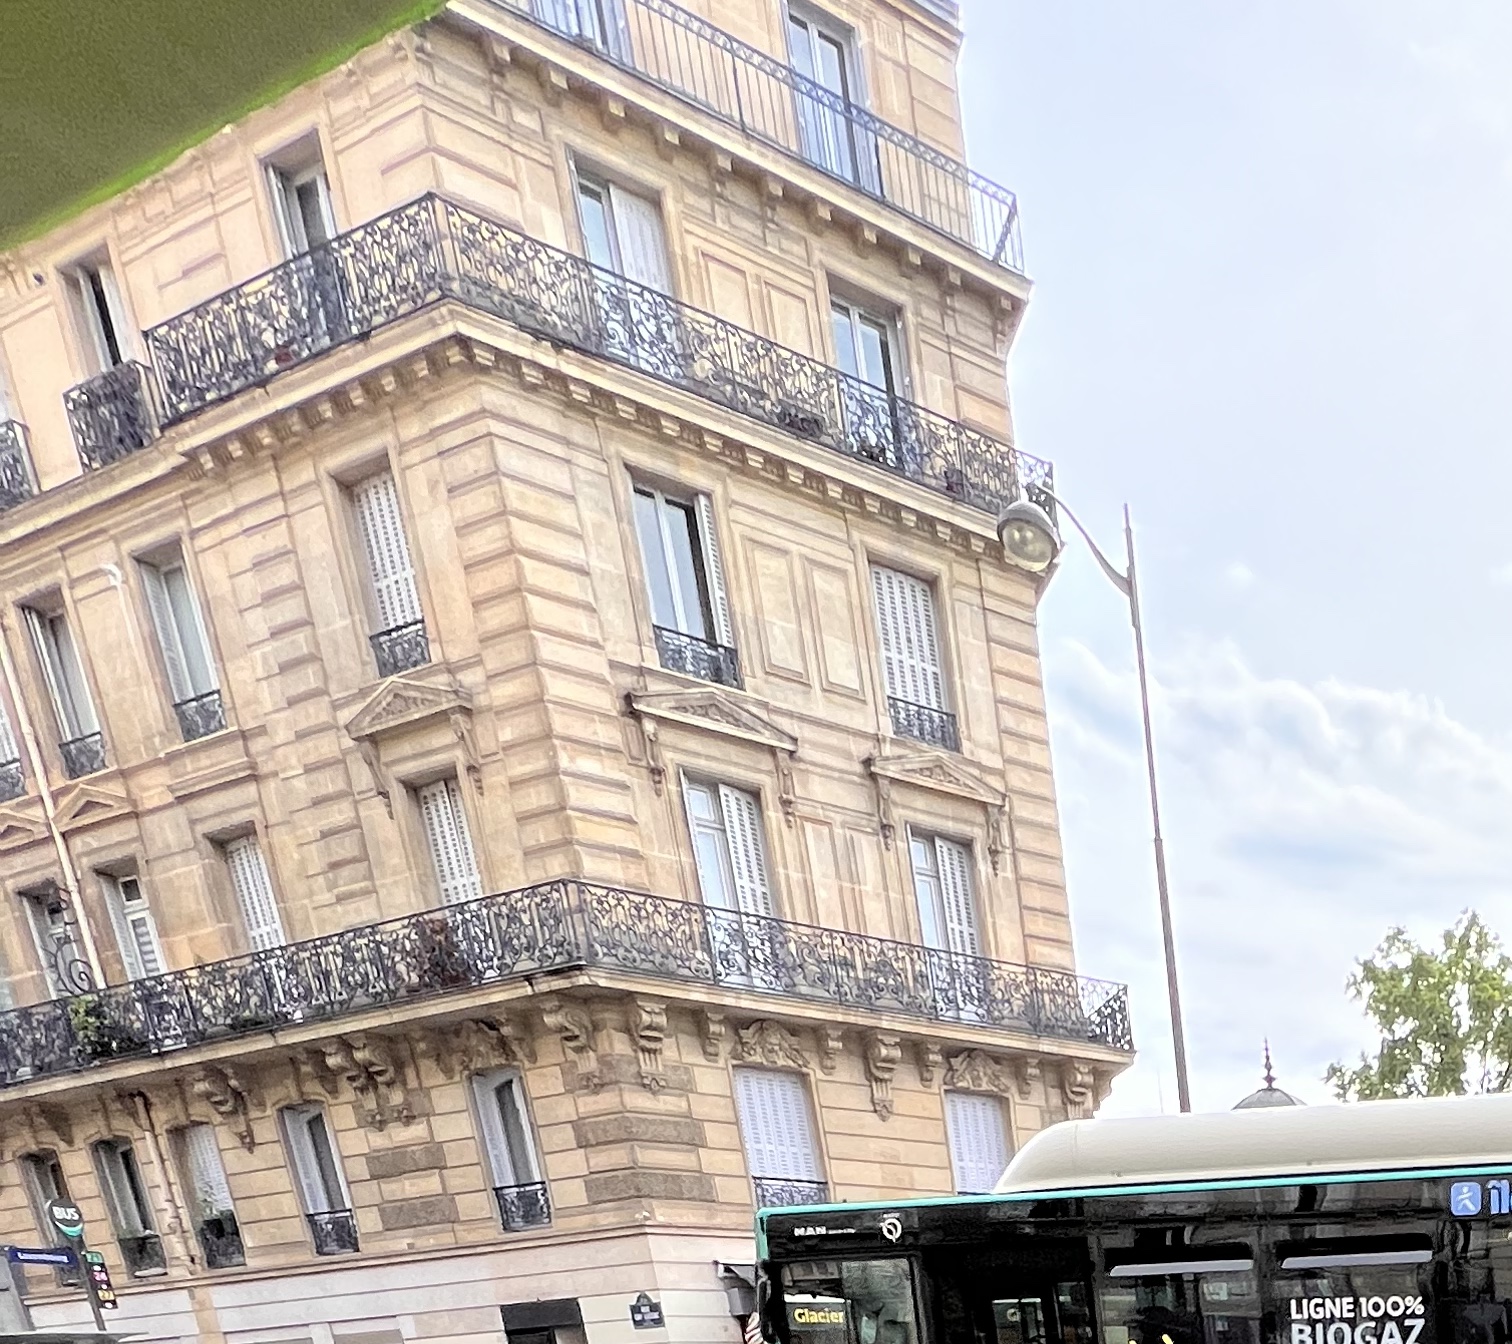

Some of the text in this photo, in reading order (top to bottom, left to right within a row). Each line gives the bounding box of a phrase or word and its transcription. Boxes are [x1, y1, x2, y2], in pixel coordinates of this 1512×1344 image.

[52, 1206, 80, 1220] BUS
[794, 1226, 827, 1236] MAN
[1290, 1296, 1425, 1319] LIGNE 100%
[794, 1308, 845, 1323] Glacier
